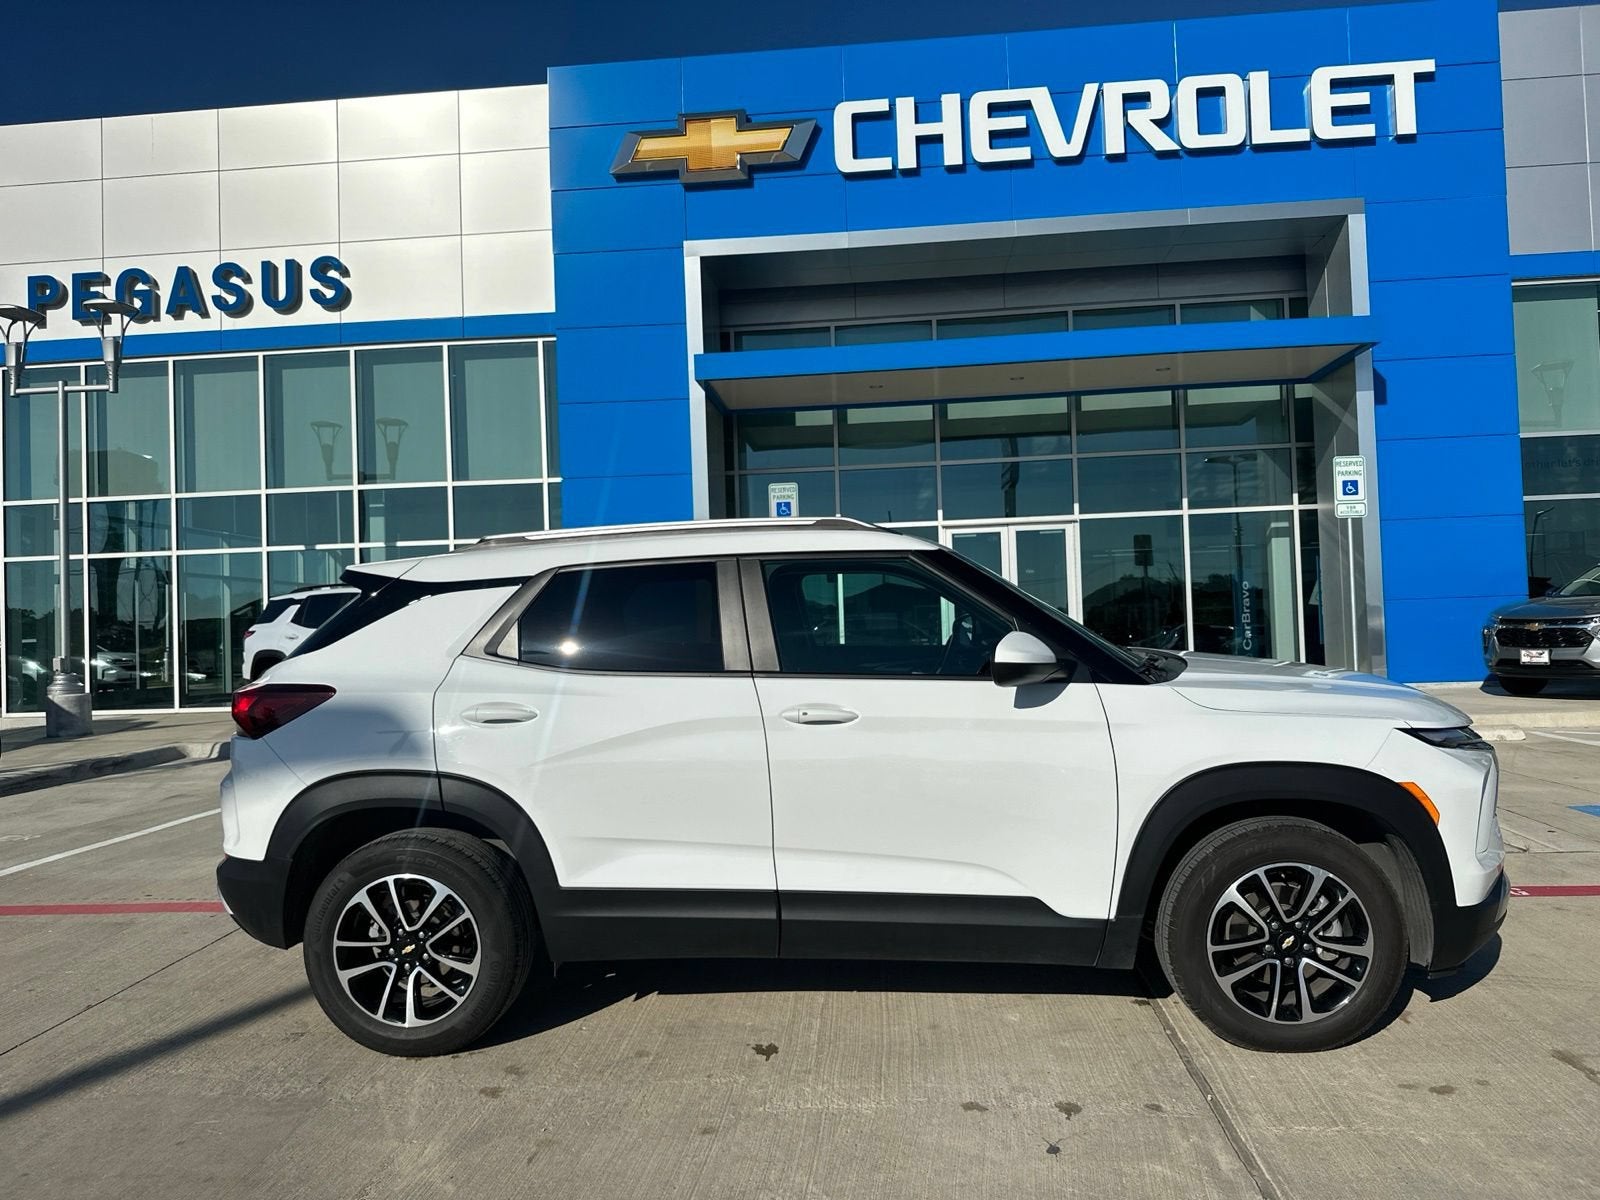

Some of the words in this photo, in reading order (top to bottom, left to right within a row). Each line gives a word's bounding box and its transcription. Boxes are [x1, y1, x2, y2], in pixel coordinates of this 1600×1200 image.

[832, 58, 1436, 174] CHEVROLET
[27, 255, 350, 327] PEGASUS
[1242, 581, 1252, 650] CarBravo
